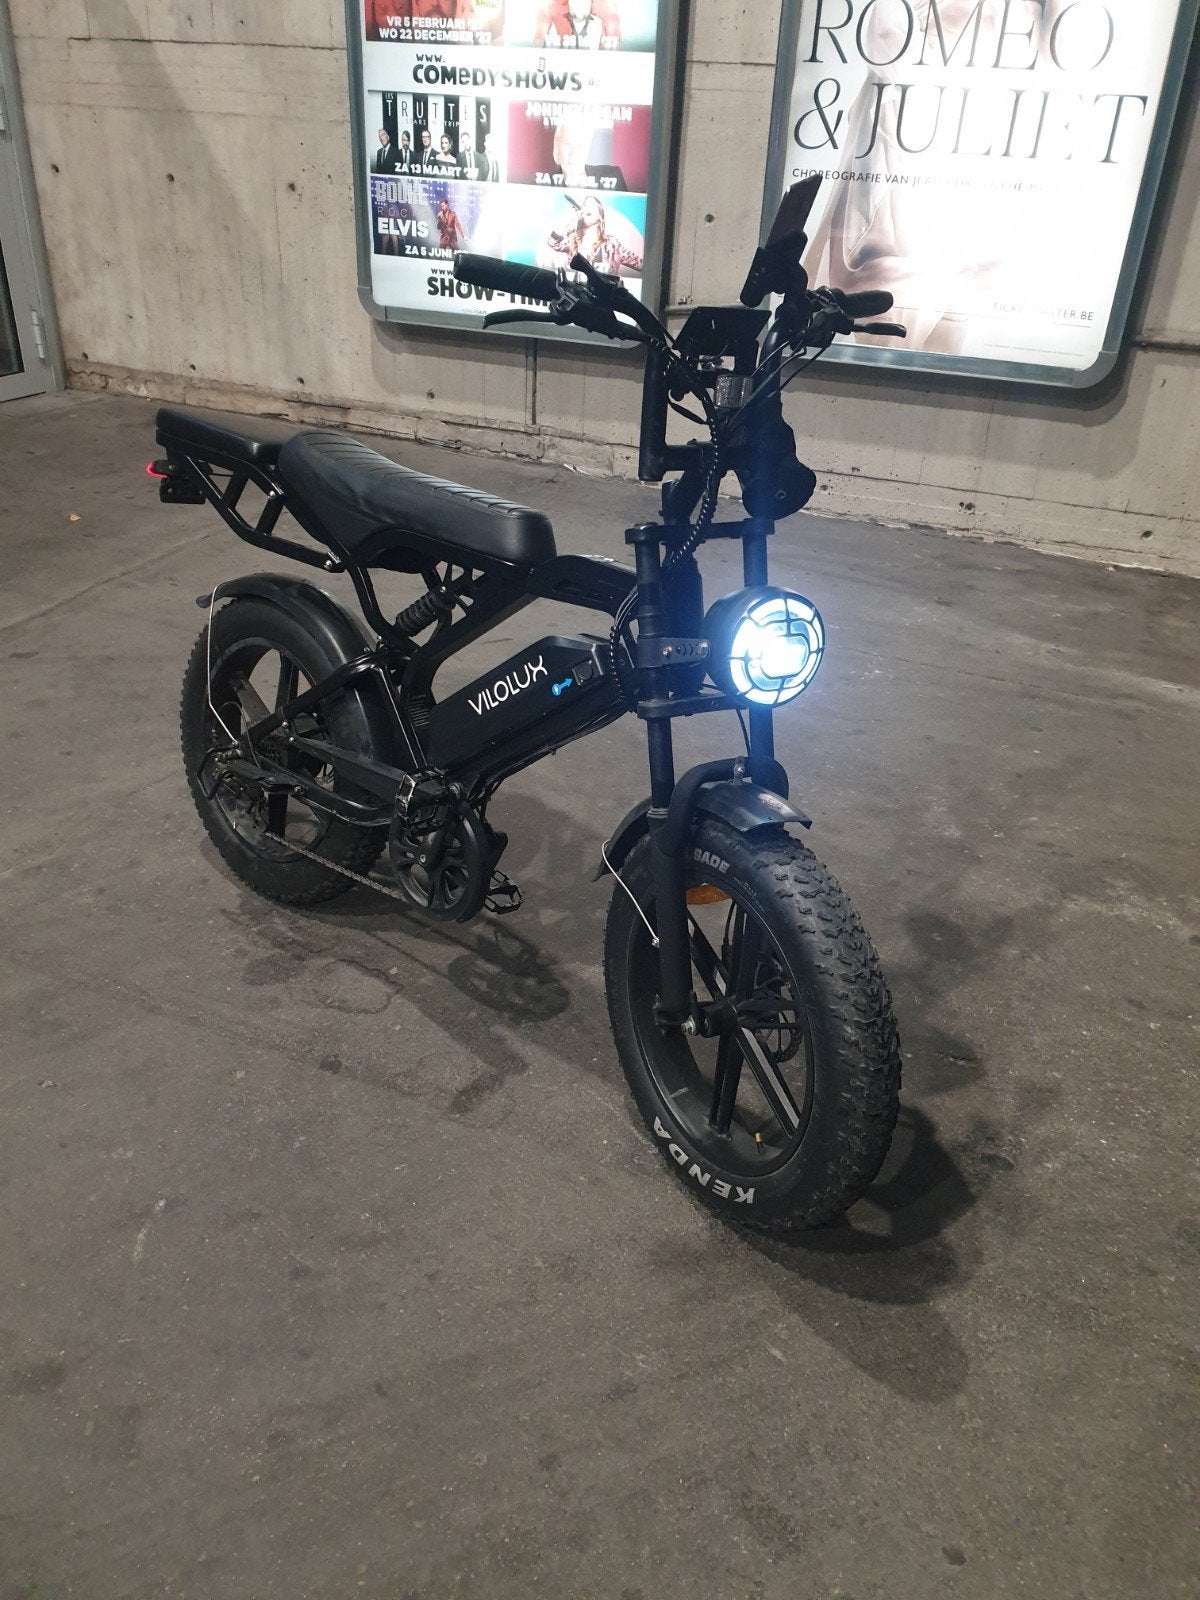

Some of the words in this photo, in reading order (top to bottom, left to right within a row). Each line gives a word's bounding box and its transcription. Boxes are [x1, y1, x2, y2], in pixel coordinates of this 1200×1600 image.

[386, 15, 402, 27] VR
[379, 27, 398, 39] WO
[400, 28, 413, 40] 22
[414, 29, 474, 43] DECEMBER
[802, 0, 1115, 72] ROMEO
[386, 99, 487, 123] TRUTTES
[793, 77, 844, 151] &
[854, 82, 1150, 164] JULIET
[395, 162, 409, 173] ZA
[411, 163, 421, 174] 13
[423, 164, 462, 177] MAART
[535, 172, 551, 183] ZA
[792, 168, 882, 185] CHOREOGRAFIE
[884, 173, 909, 185] VAN
[377, 217, 429, 238] ELVIS
[405, 244, 419, 256] ZA
[420, 246, 427, 256] 5
[428, 247, 453, 259] JUNI
[467, 654, 549, 716] VILOLUX
[653, 1116, 756, 1205] KENDA
